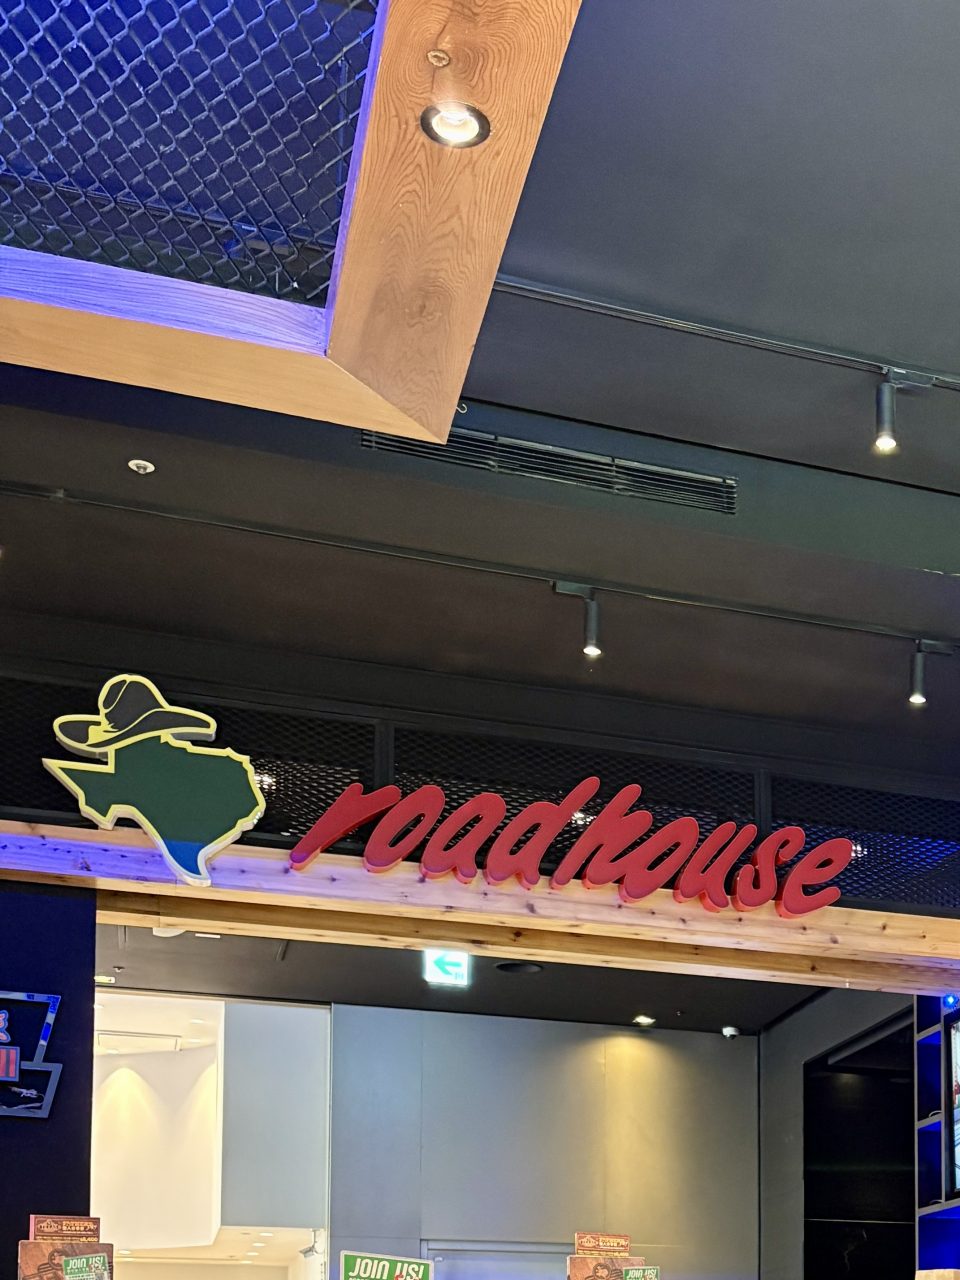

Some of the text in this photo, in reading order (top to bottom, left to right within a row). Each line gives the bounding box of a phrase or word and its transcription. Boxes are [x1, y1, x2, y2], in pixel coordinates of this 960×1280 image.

[289, 776, 853, 918] roadhouse
[67, 1258, 87, 1270] JOIN
[348, 1258, 390, 1280] JOIN
